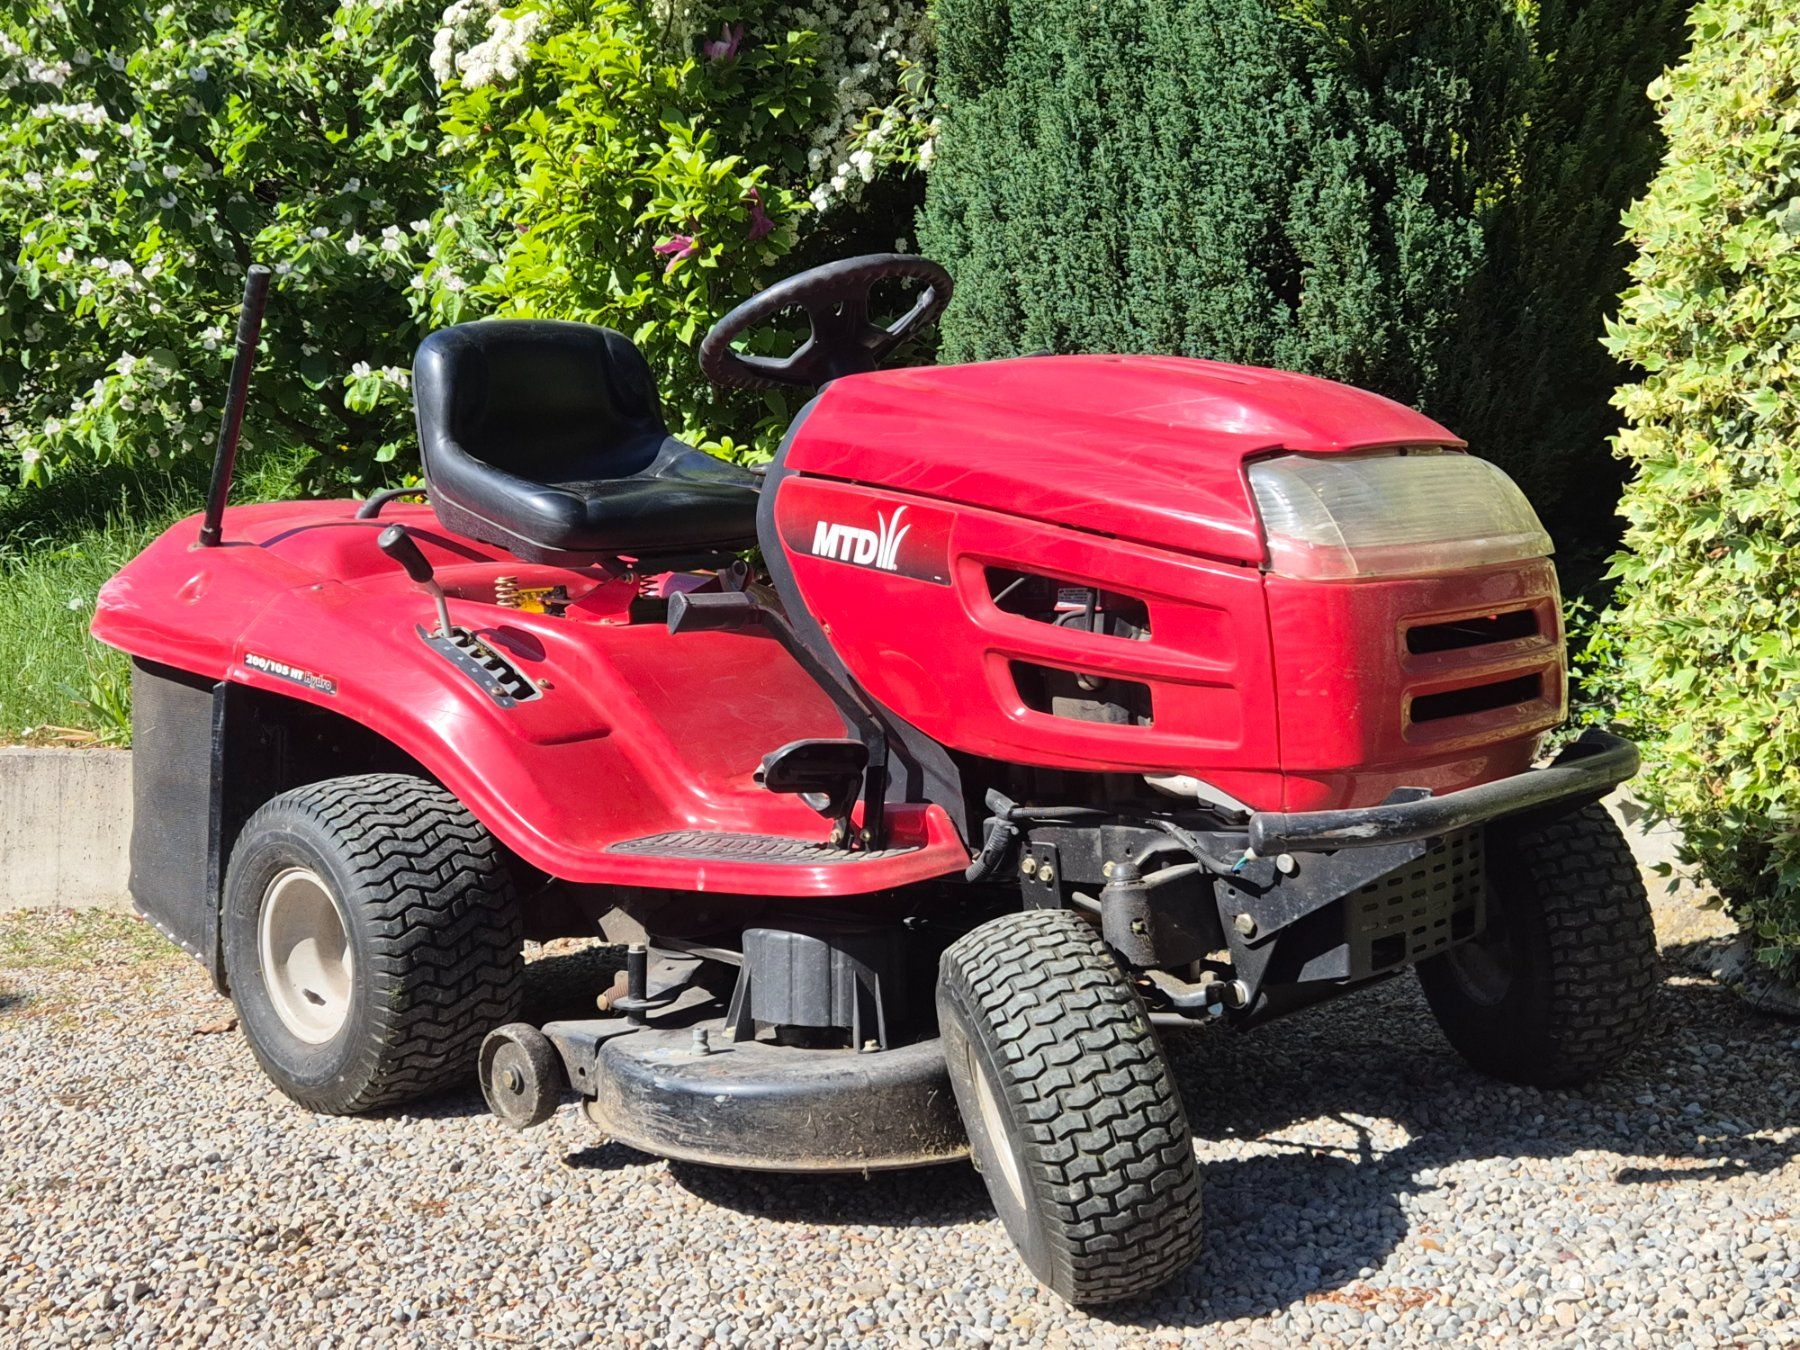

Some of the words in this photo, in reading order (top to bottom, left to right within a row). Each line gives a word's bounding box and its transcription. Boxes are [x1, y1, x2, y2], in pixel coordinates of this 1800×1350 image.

[812, 521, 878, 565] MTD
[246, 653, 289, 675] 200/105
[304, 670, 332, 688] Hydro
